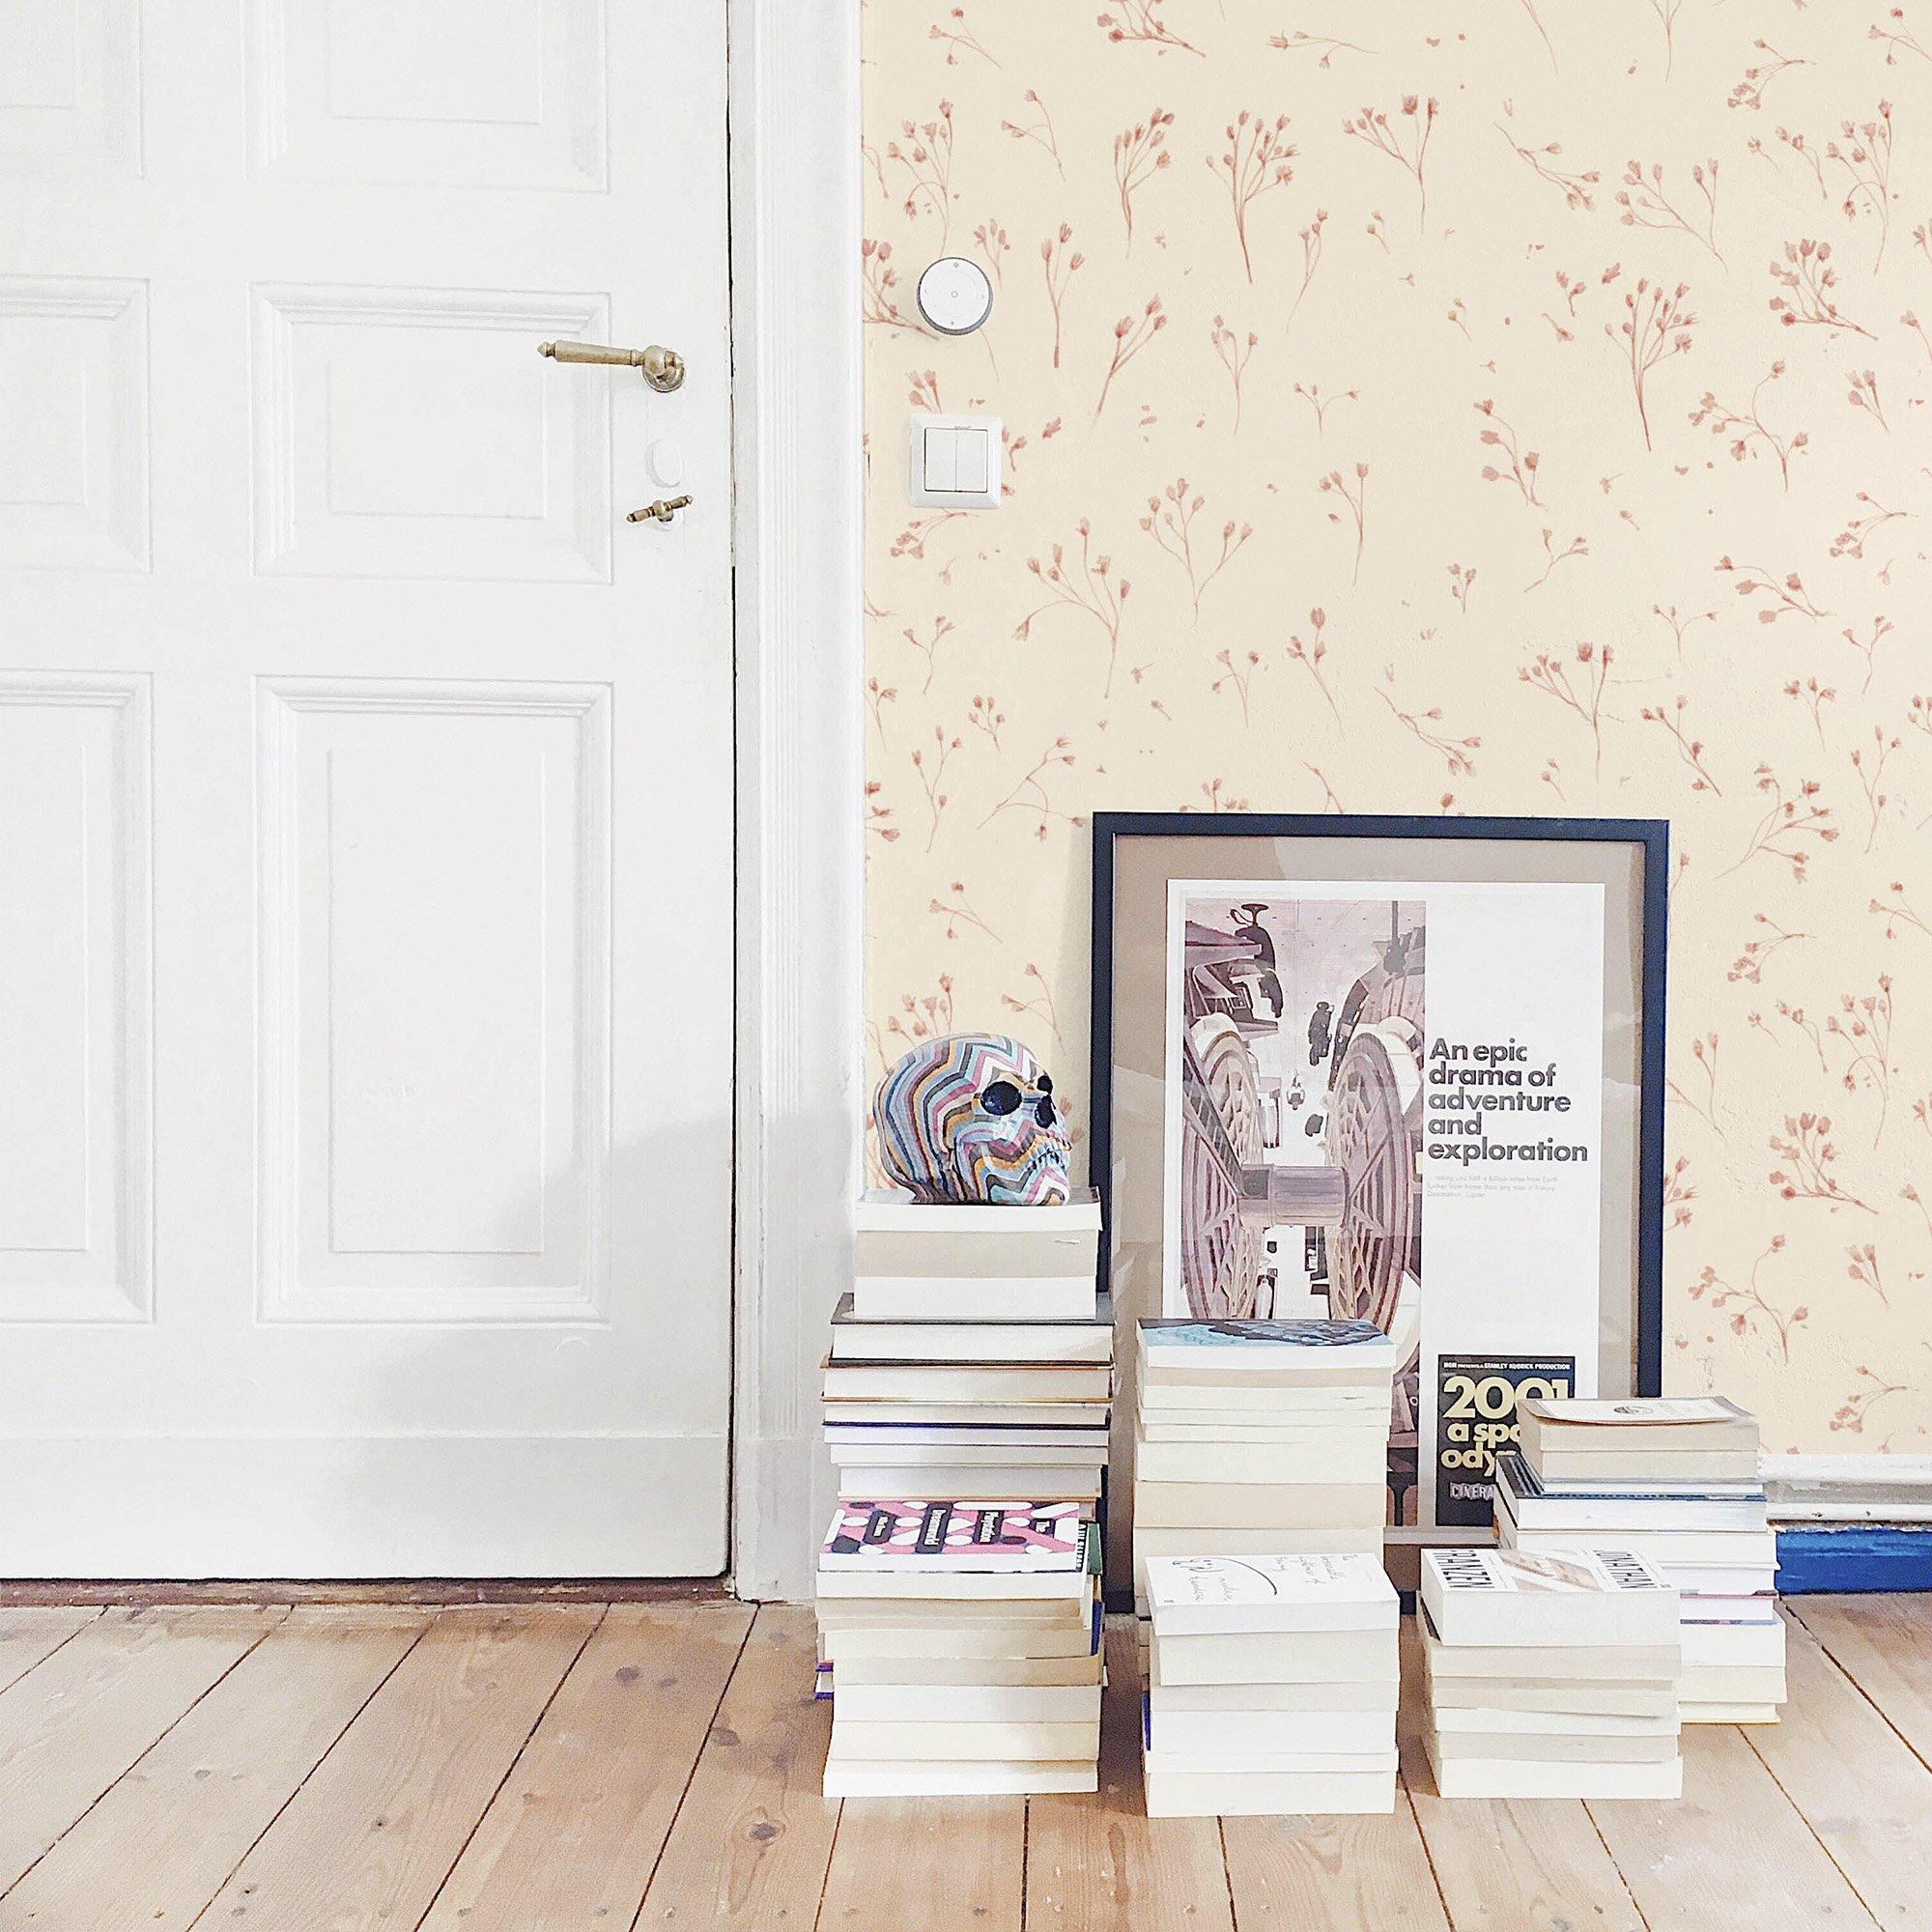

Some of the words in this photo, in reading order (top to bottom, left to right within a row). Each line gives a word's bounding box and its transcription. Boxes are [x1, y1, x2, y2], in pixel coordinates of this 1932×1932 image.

[1430, 1037, 1468, 1060] An
[1473, 1037, 1527, 1067] epic
[1429, 1061, 1522, 1086] drama
[1527, 1064, 1556, 1087] of
[1428, 1087, 1572, 1112] adventure
[1428, 1112, 1482, 1135] and
[1428, 1137, 1588, 1166] exploration
[1447, 1423, 1469, 1442] a
